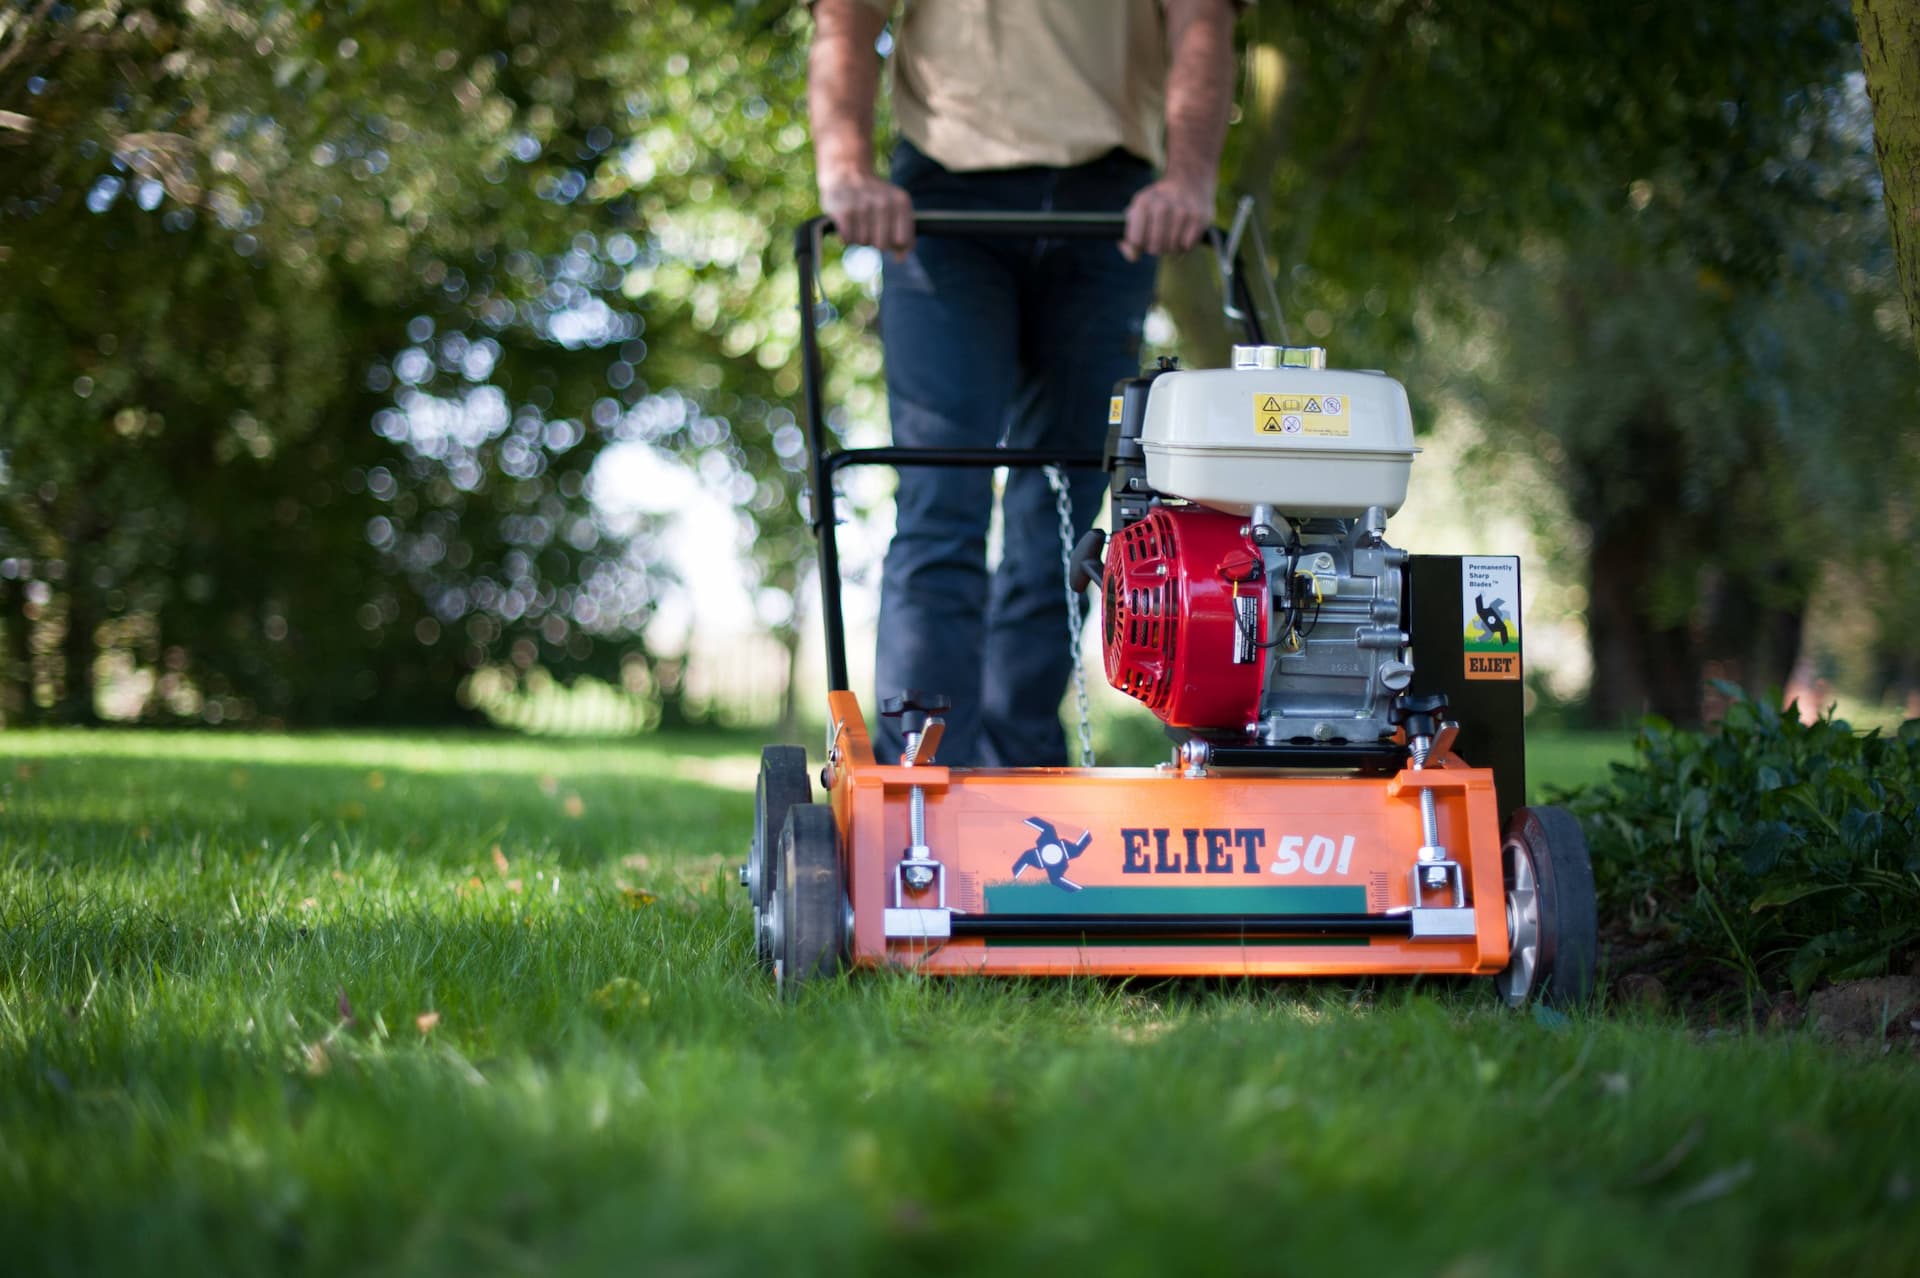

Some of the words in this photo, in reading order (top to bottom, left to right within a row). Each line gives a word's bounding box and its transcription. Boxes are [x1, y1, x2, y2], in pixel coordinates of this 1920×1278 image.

[1469, 564, 1512, 572] Permanently
[1469, 657, 1512, 673] ELIET
[1120, 828, 1266, 874] ELIET
[1270, 835, 1356, 875] 501
